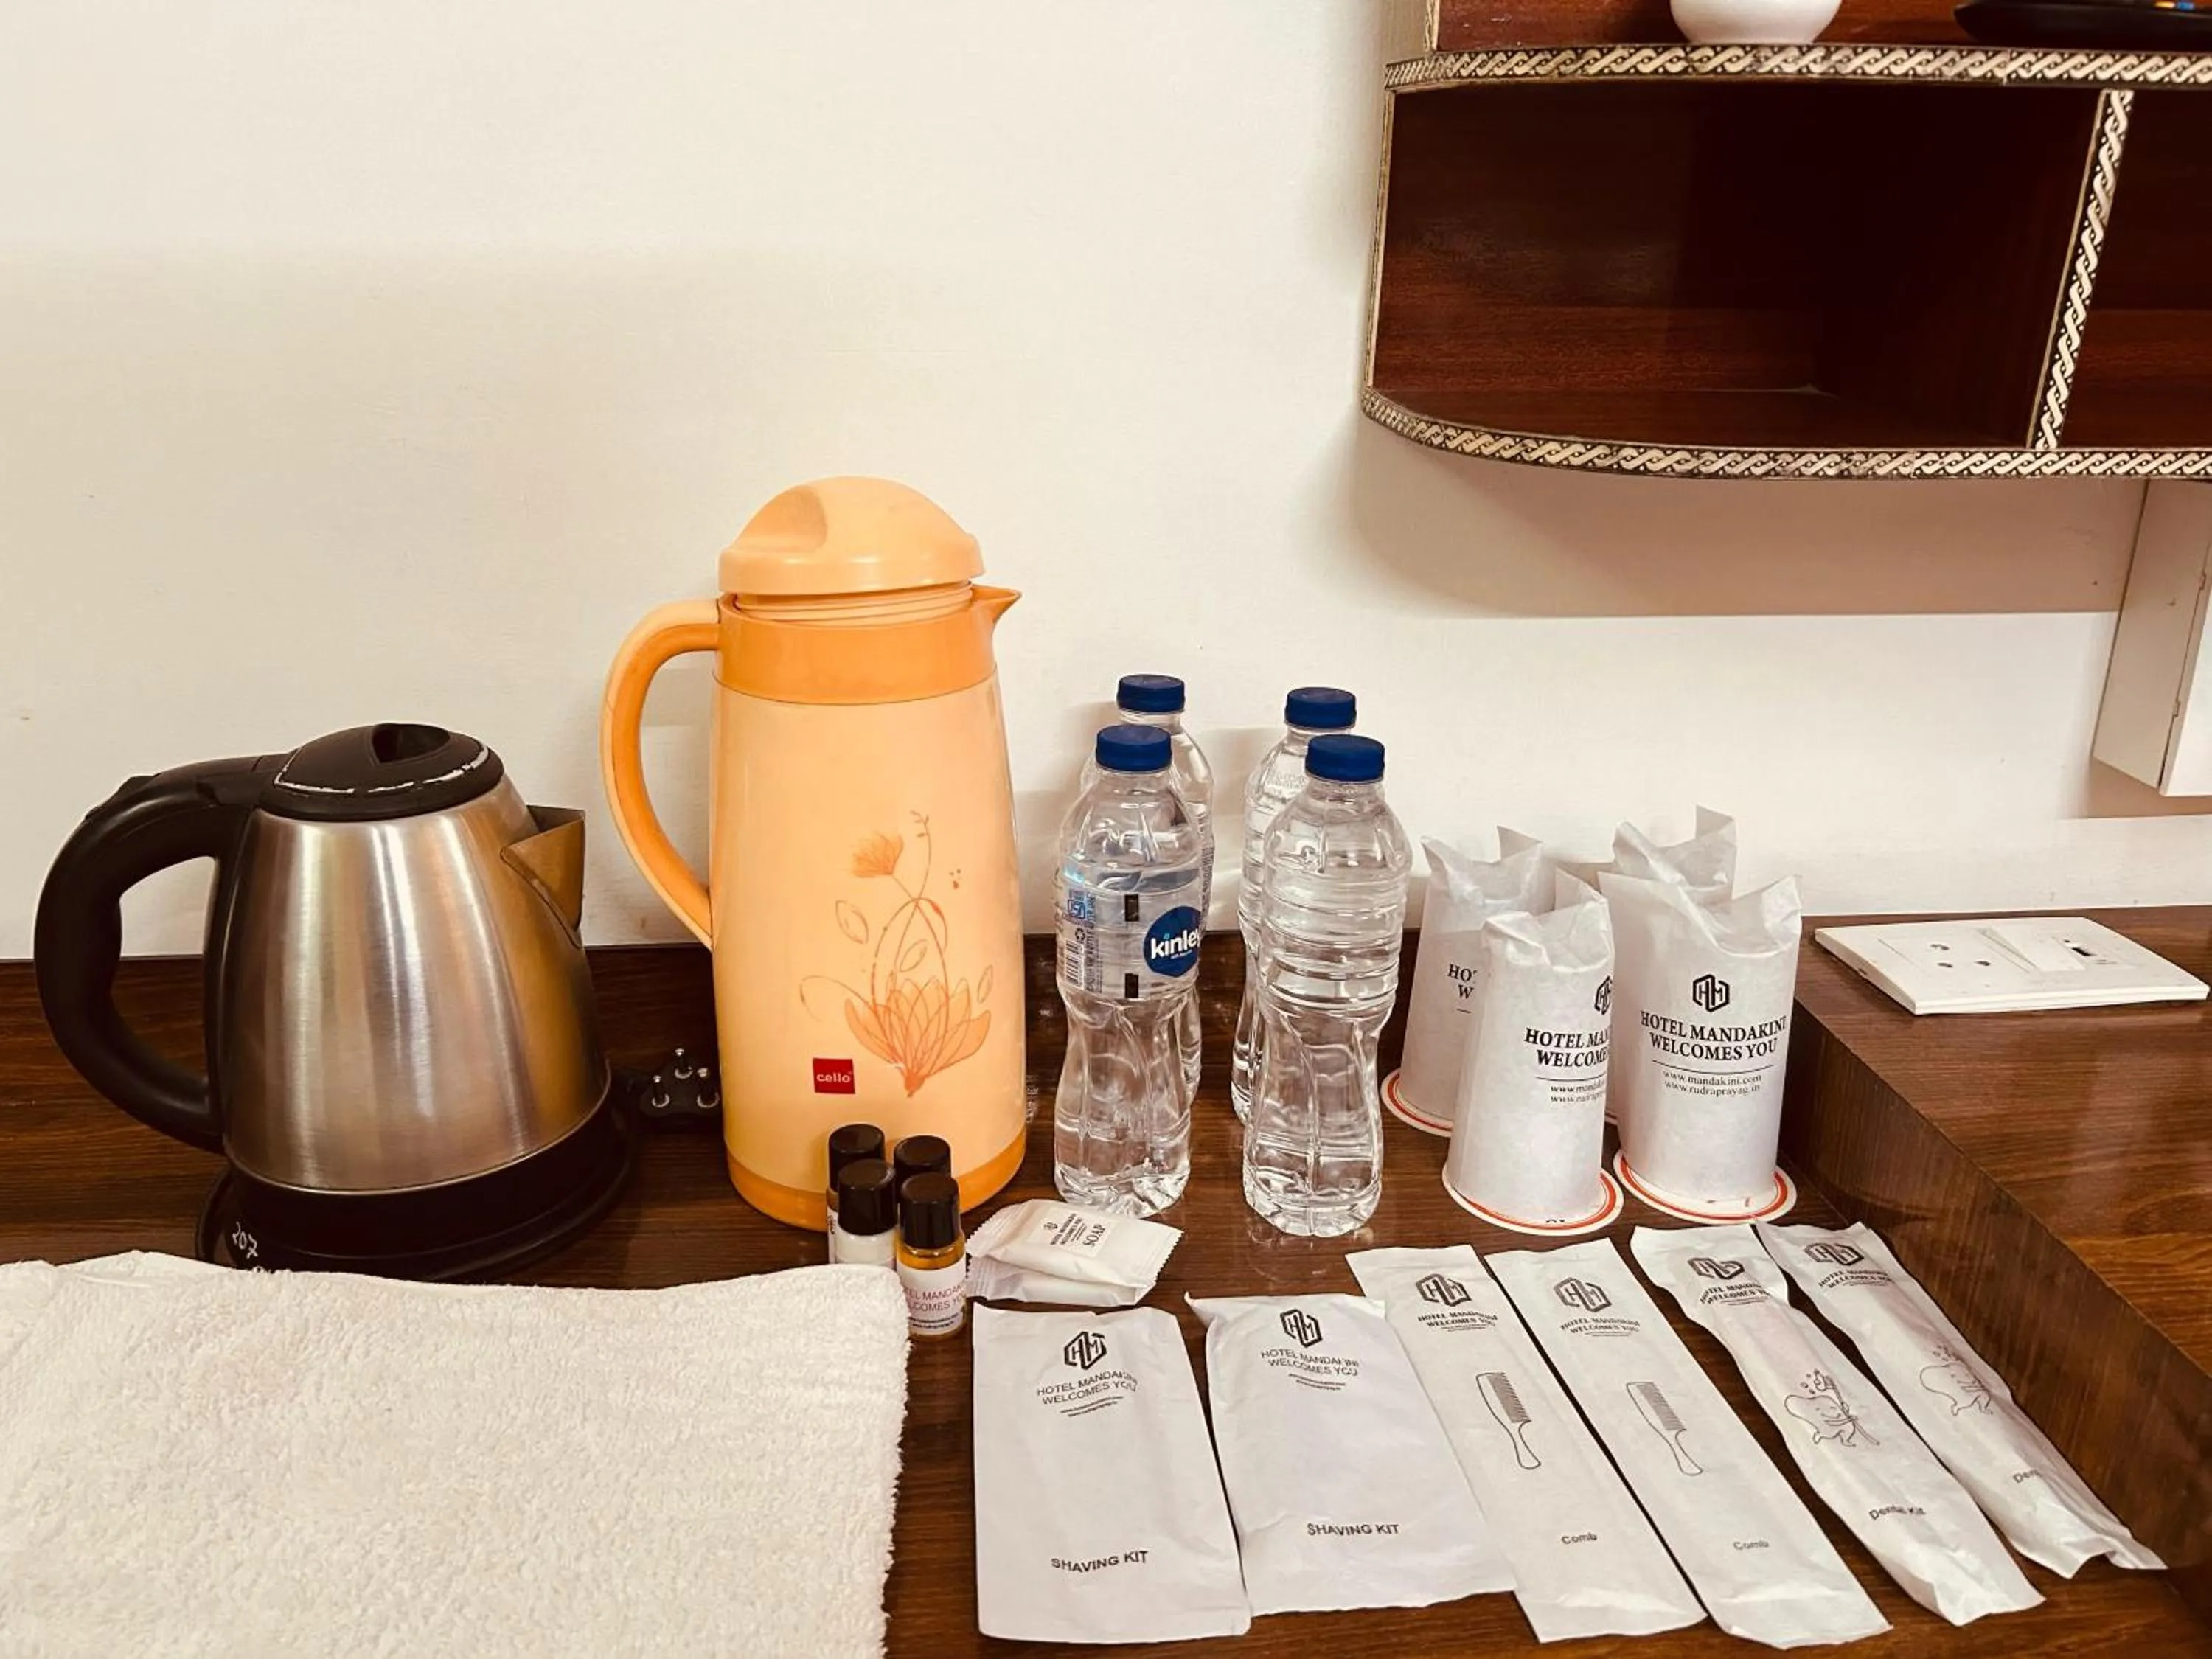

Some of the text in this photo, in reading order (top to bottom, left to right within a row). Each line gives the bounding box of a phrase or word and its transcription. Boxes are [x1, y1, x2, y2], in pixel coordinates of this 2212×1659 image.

[1447, 963, 1477, 980] HO
[1640, 1010, 1787, 1042] HOTEL MANDAKINI
[1523, 1027, 1585, 1048] HOTEL
[1649, 1032, 1778, 1061] WELCOMES YOU
[816, 1072, 850, 1083] cello
[1082, 1224, 1105, 1247] SOAP
[1261, 1349, 1298, 1359] HOTEL
[1268, 1357, 1332, 1374] WELCOMES
[1037, 1382, 1076, 1396] HOTEL
[1043, 1381, 1110, 1405] WELCOMES
[1307, 1523, 1399, 1536] SHAVING KIT
[1561, 1531, 1597, 1544] Comb
[1051, 1551, 1148, 1573] SHAVING KIT
